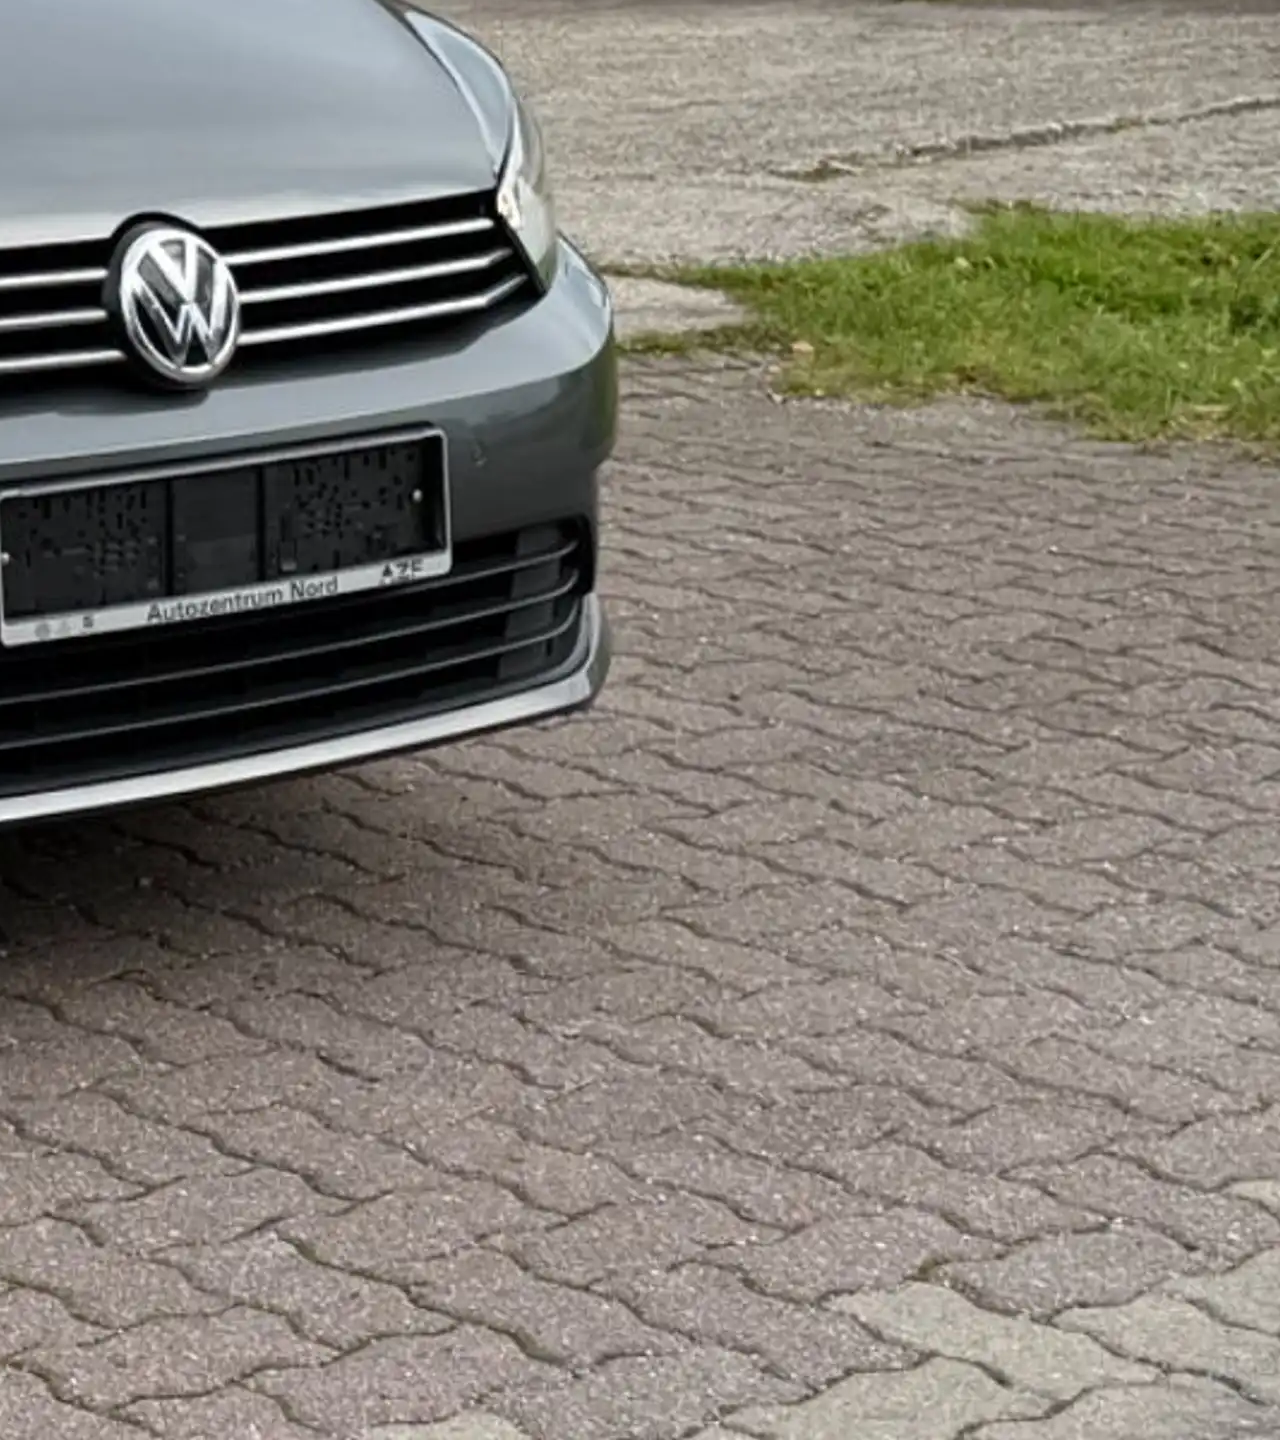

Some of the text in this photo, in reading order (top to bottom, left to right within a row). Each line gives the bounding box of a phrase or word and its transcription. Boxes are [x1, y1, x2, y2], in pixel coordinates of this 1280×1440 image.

[120, 229, 239, 382] VW
[147, 587, 283, 623] Autozentrum
[290, 575, 338, 599] Nord
